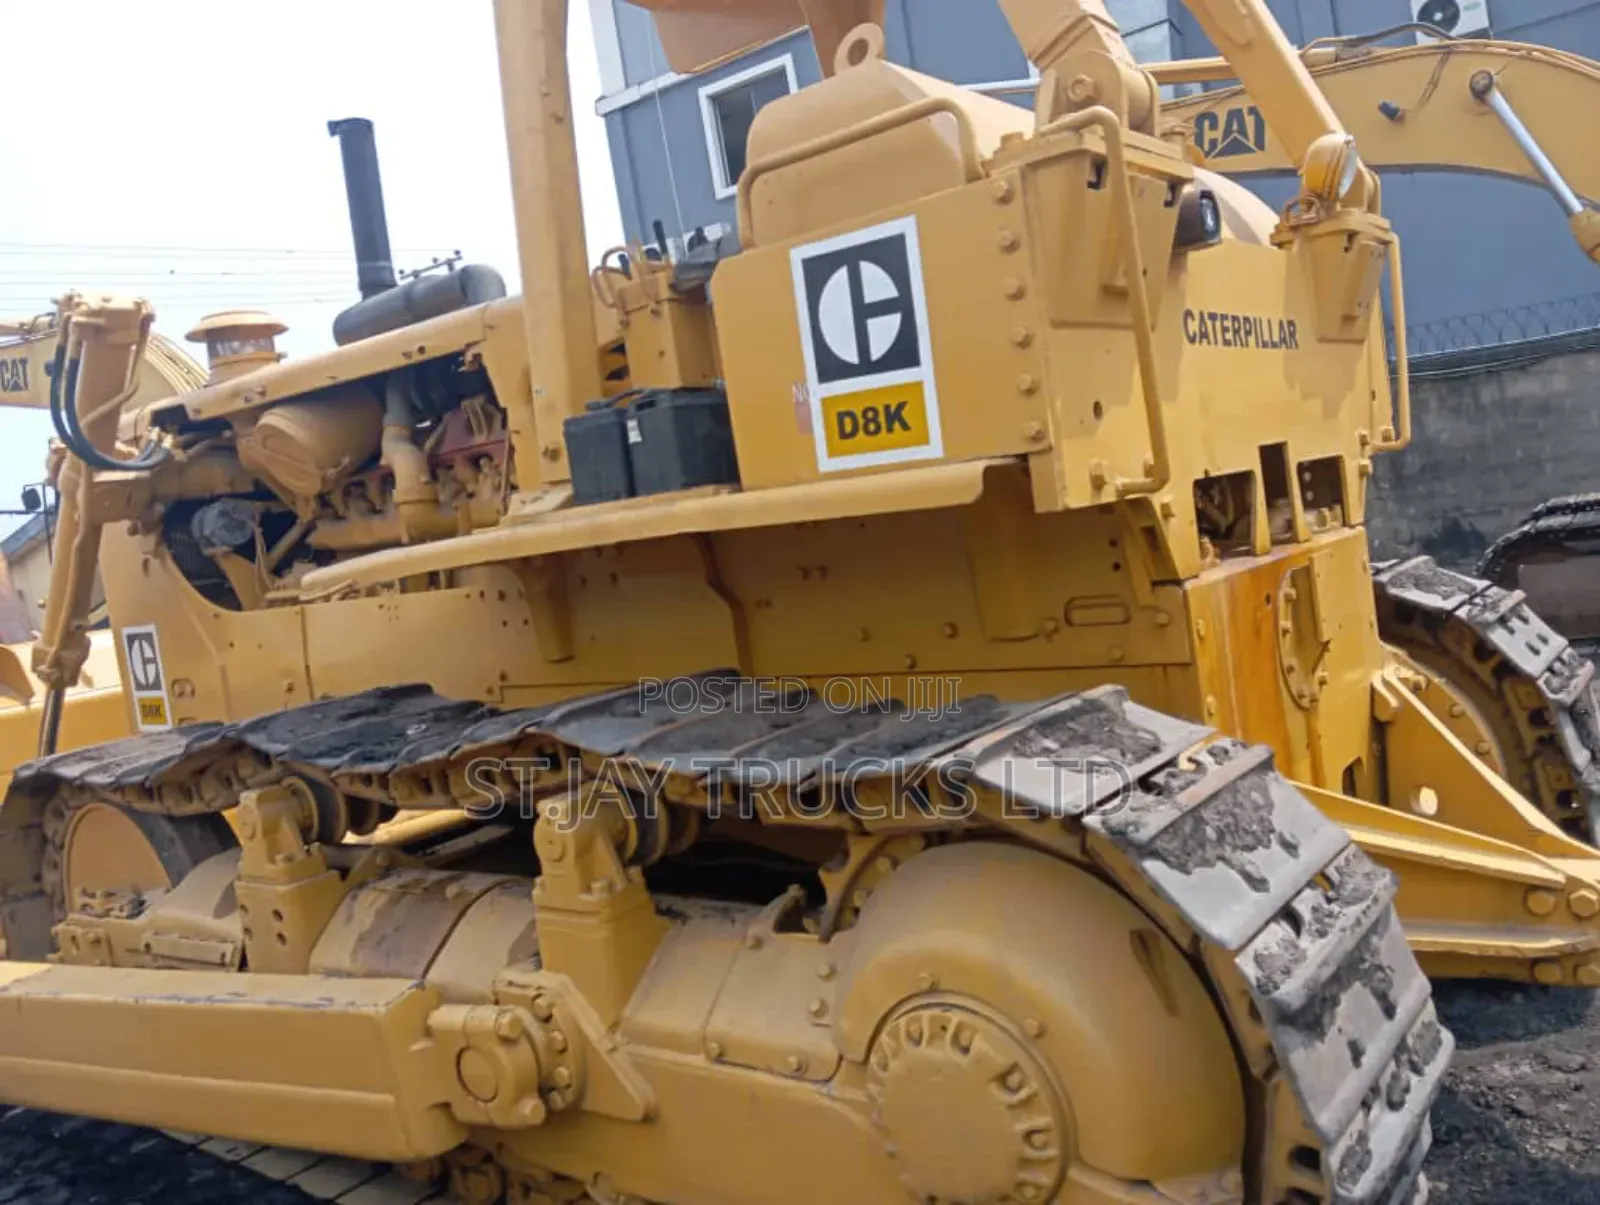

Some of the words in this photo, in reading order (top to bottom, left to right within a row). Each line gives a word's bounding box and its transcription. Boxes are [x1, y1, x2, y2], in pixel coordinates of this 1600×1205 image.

[1195, 106, 1265, 159] CAT
[1183, 308, 1299, 349] CATERPILLAR
[0, 357, 29, 392] CAT
[836, 401, 911, 440] D8K
